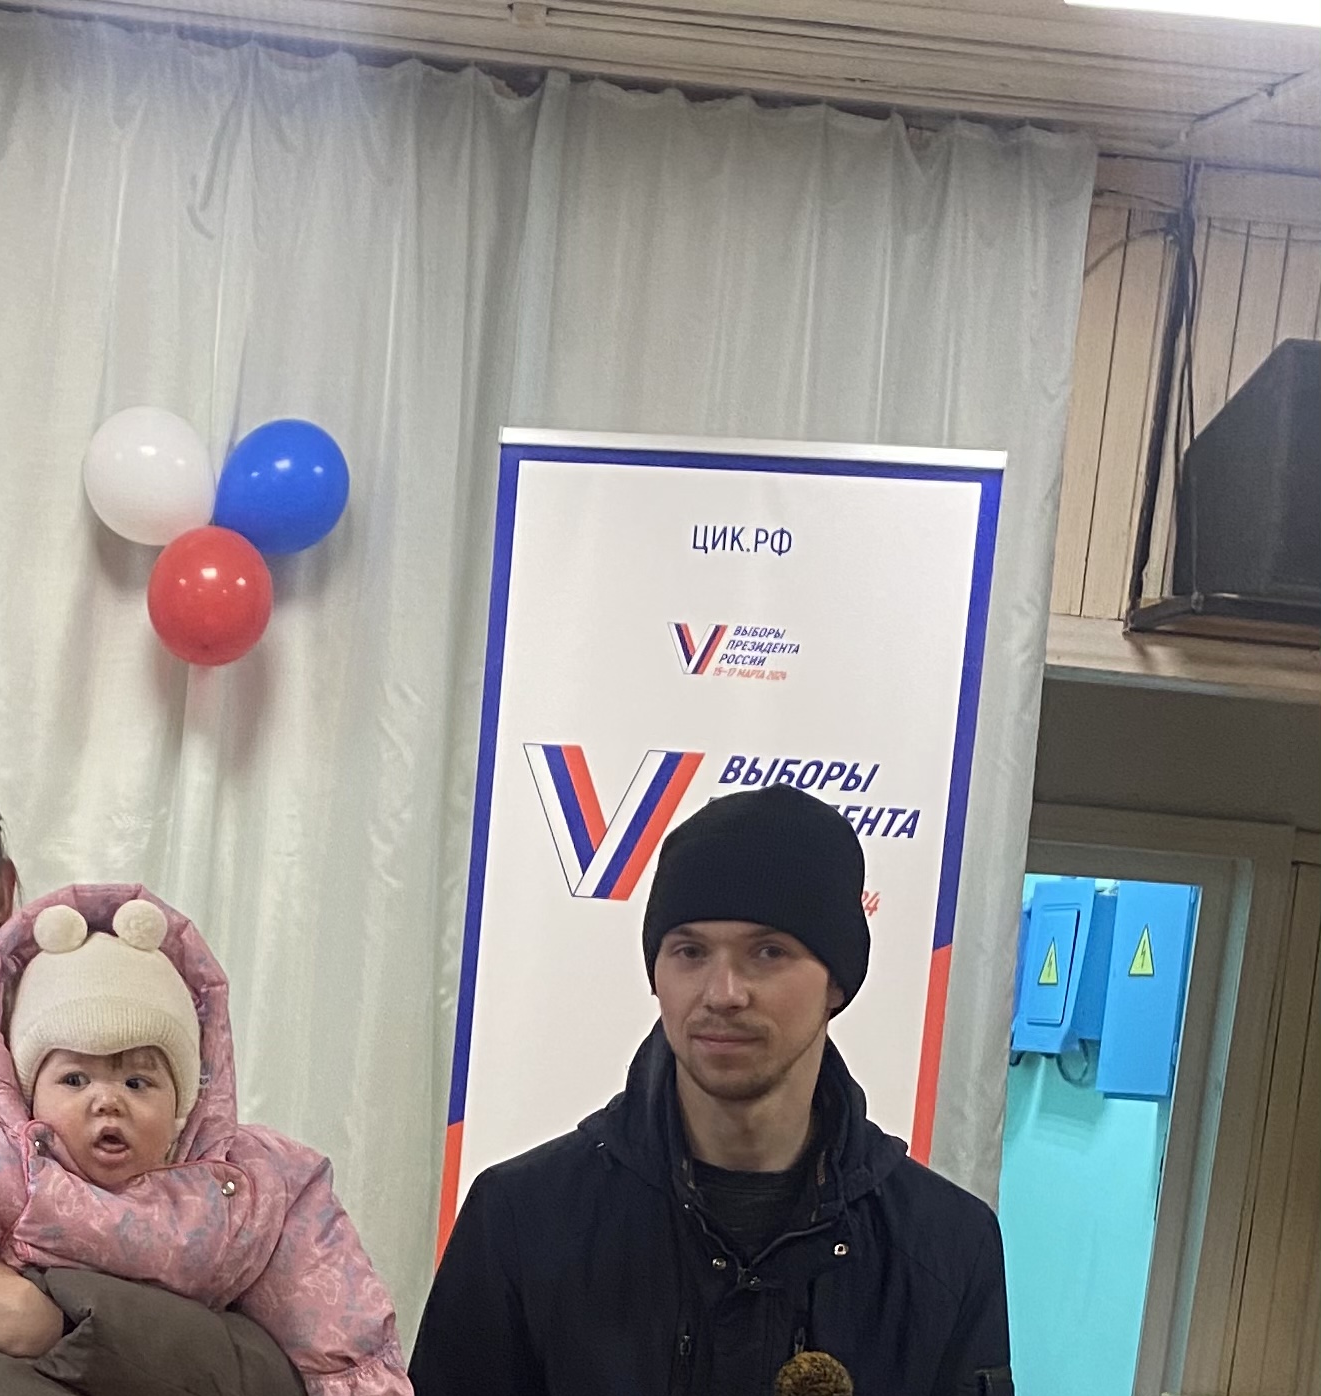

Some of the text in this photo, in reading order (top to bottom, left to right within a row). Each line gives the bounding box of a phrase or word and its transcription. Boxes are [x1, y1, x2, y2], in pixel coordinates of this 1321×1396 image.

[692, 524, 793, 557] ЦИК.РФ
[733, 625, 787, 640] ВЫБОРЫ
[725, 639, 801, 655] ПРЕЗИДЕНТА
[718, 653, 767, 667] РОССИИ
[718, 755, 880, 793] ВЫБОРЫ
